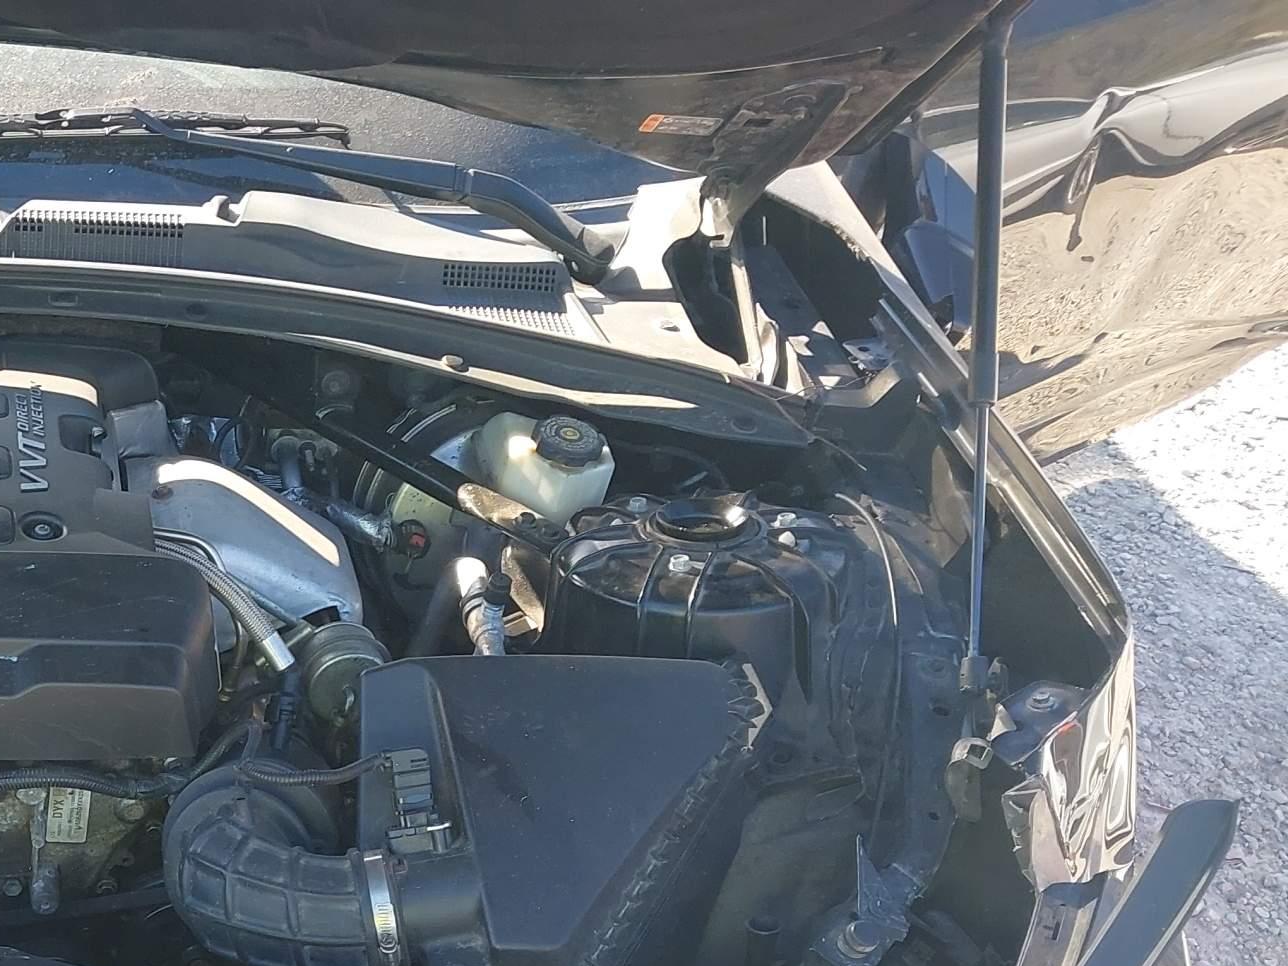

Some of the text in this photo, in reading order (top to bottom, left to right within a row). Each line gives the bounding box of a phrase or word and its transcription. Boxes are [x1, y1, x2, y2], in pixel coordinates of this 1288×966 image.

[15, 393, 29, 432] DIRECT
[17, 431, 49, 491] VVT
[52, 799, 64, 819] DYX
